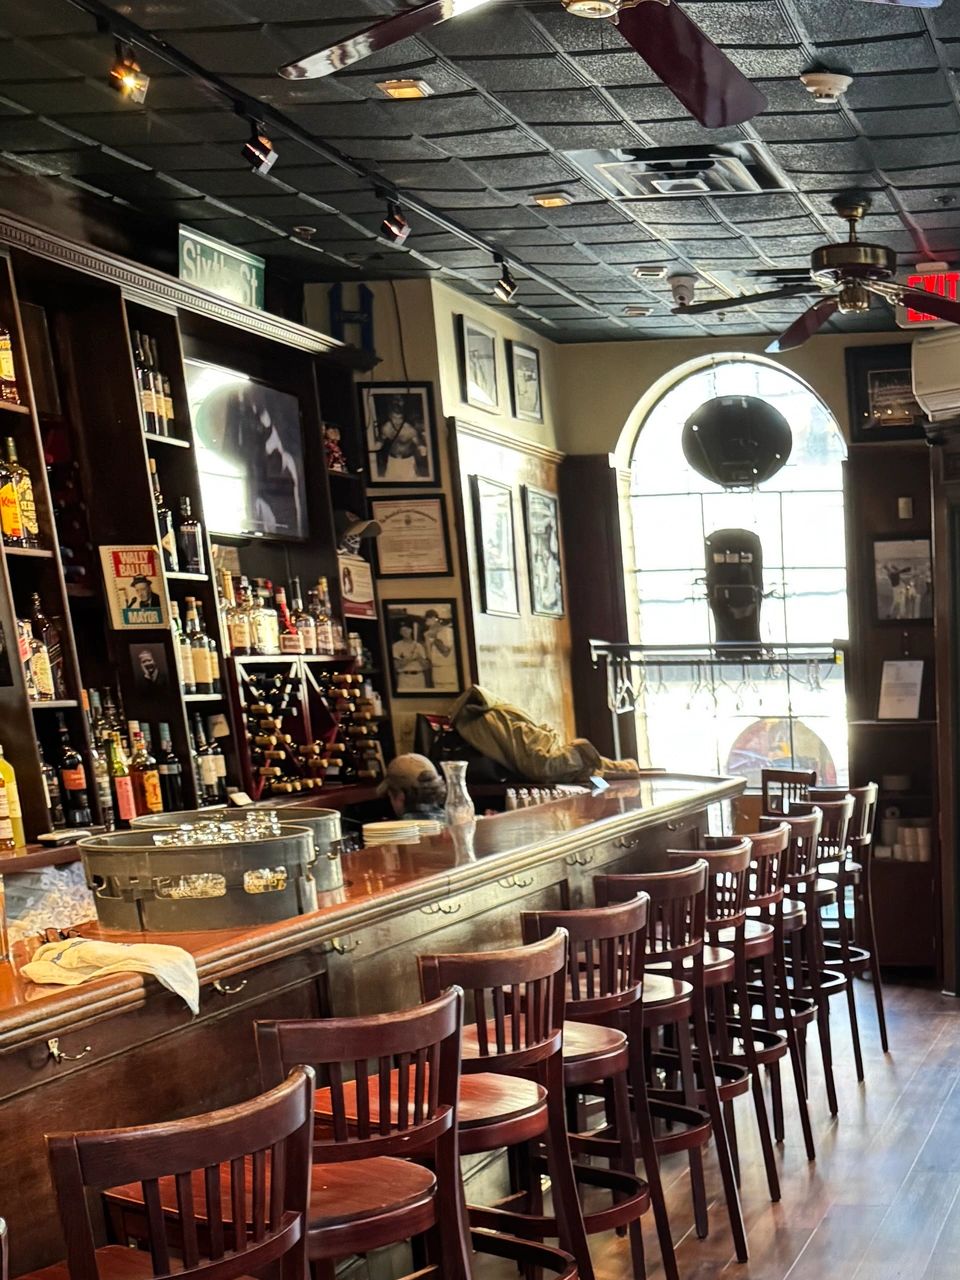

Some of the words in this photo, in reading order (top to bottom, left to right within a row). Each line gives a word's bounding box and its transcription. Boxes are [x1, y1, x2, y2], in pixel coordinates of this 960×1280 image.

[183, 240, 230, 291] Sixth
[119, 551, 149, 563] WALLY
[119, 563, 153, 576] BALLOU
[127, 611, 159, 623] MAYOR
